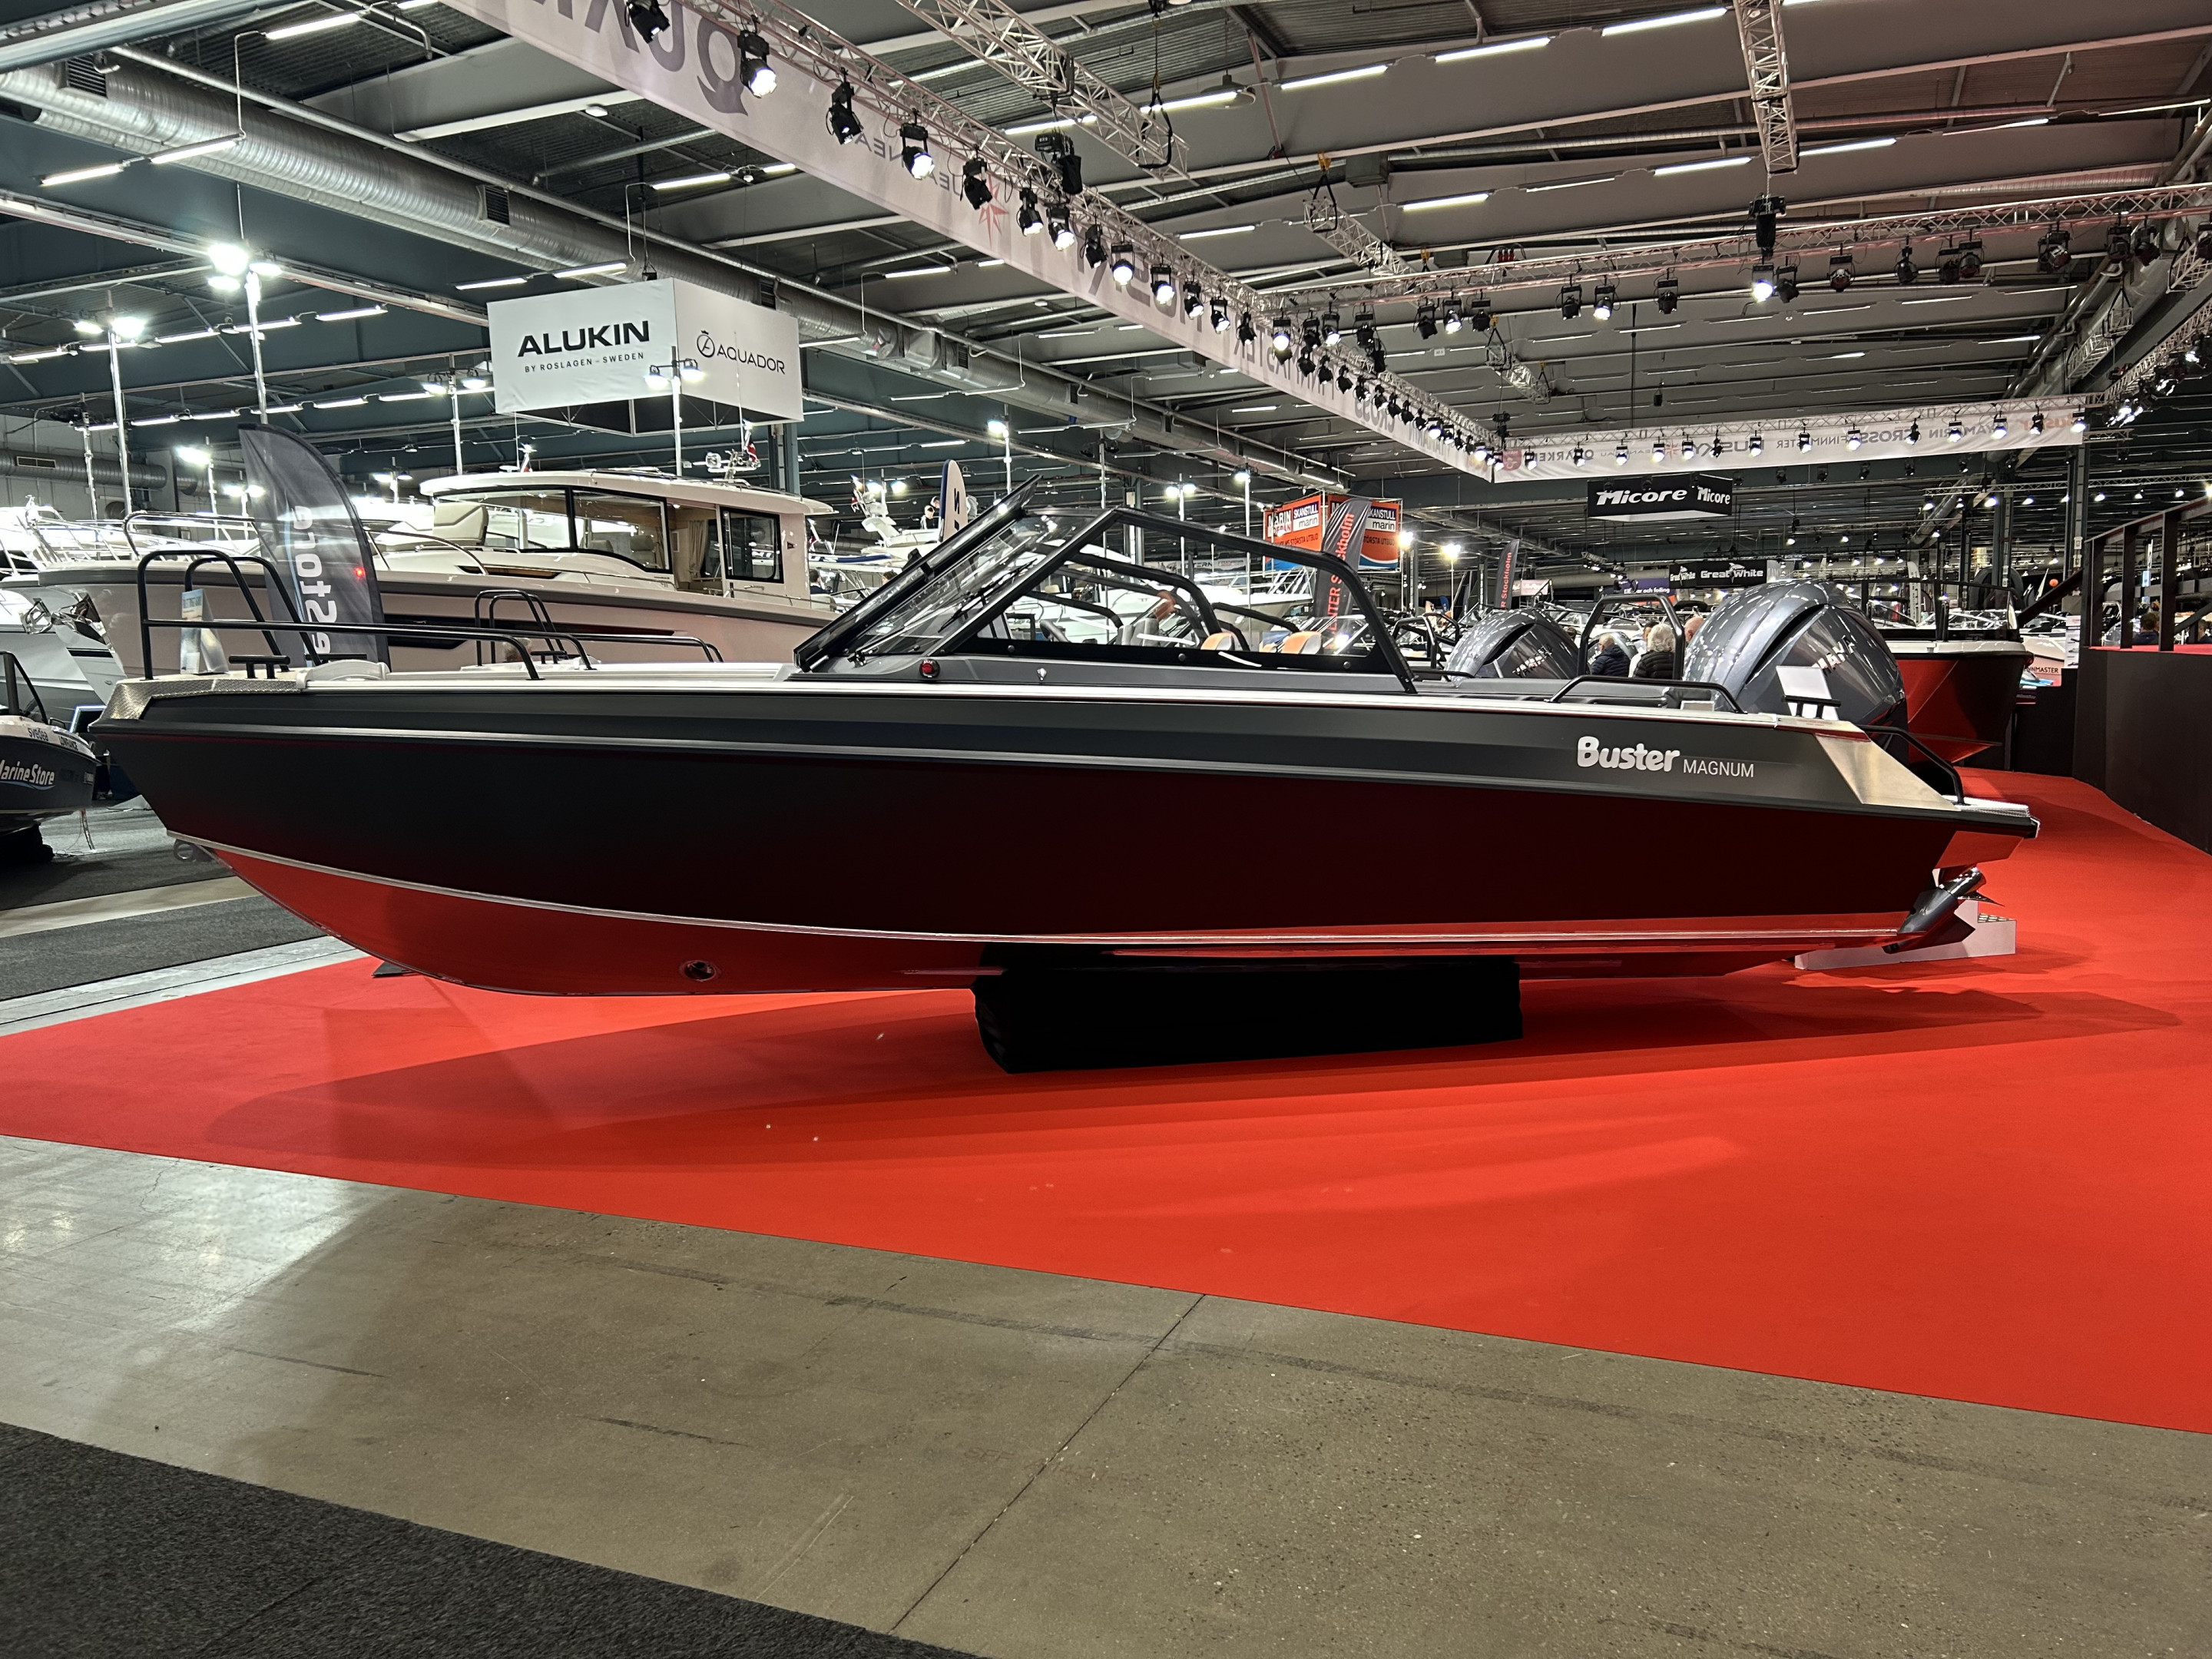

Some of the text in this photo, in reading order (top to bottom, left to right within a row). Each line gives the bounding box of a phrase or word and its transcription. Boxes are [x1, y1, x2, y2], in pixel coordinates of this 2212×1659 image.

[517, 320, 650, 357] ALUKIN
[525, 365, 536, 373] BY
[540, 358, 592, 371] ROSLAGEN
[603, 352, 644, 363] SWEDEN
[717, 343, 786, 375] AQUADOR
[1596, 489, 1687, 505] Micore
[1697, 485, 1730, 505] Micore
[1293, 504, 1318, 519] SKANSTULL
[1299, 516, 1318, 528] marin
[1372, 521, 1395, 530] marin
[1363, 535, 1380, 544] TÖRSTA
[1327, 512, 1355, 634] ENTER Sckholm
[1502, 552, 1512, 599] Stockholm
[1700, 570, 1731, 578] Great
[1734, 569, 1763, 578] White
[1577, 736, 1754, 778] Buster MAGNUM
